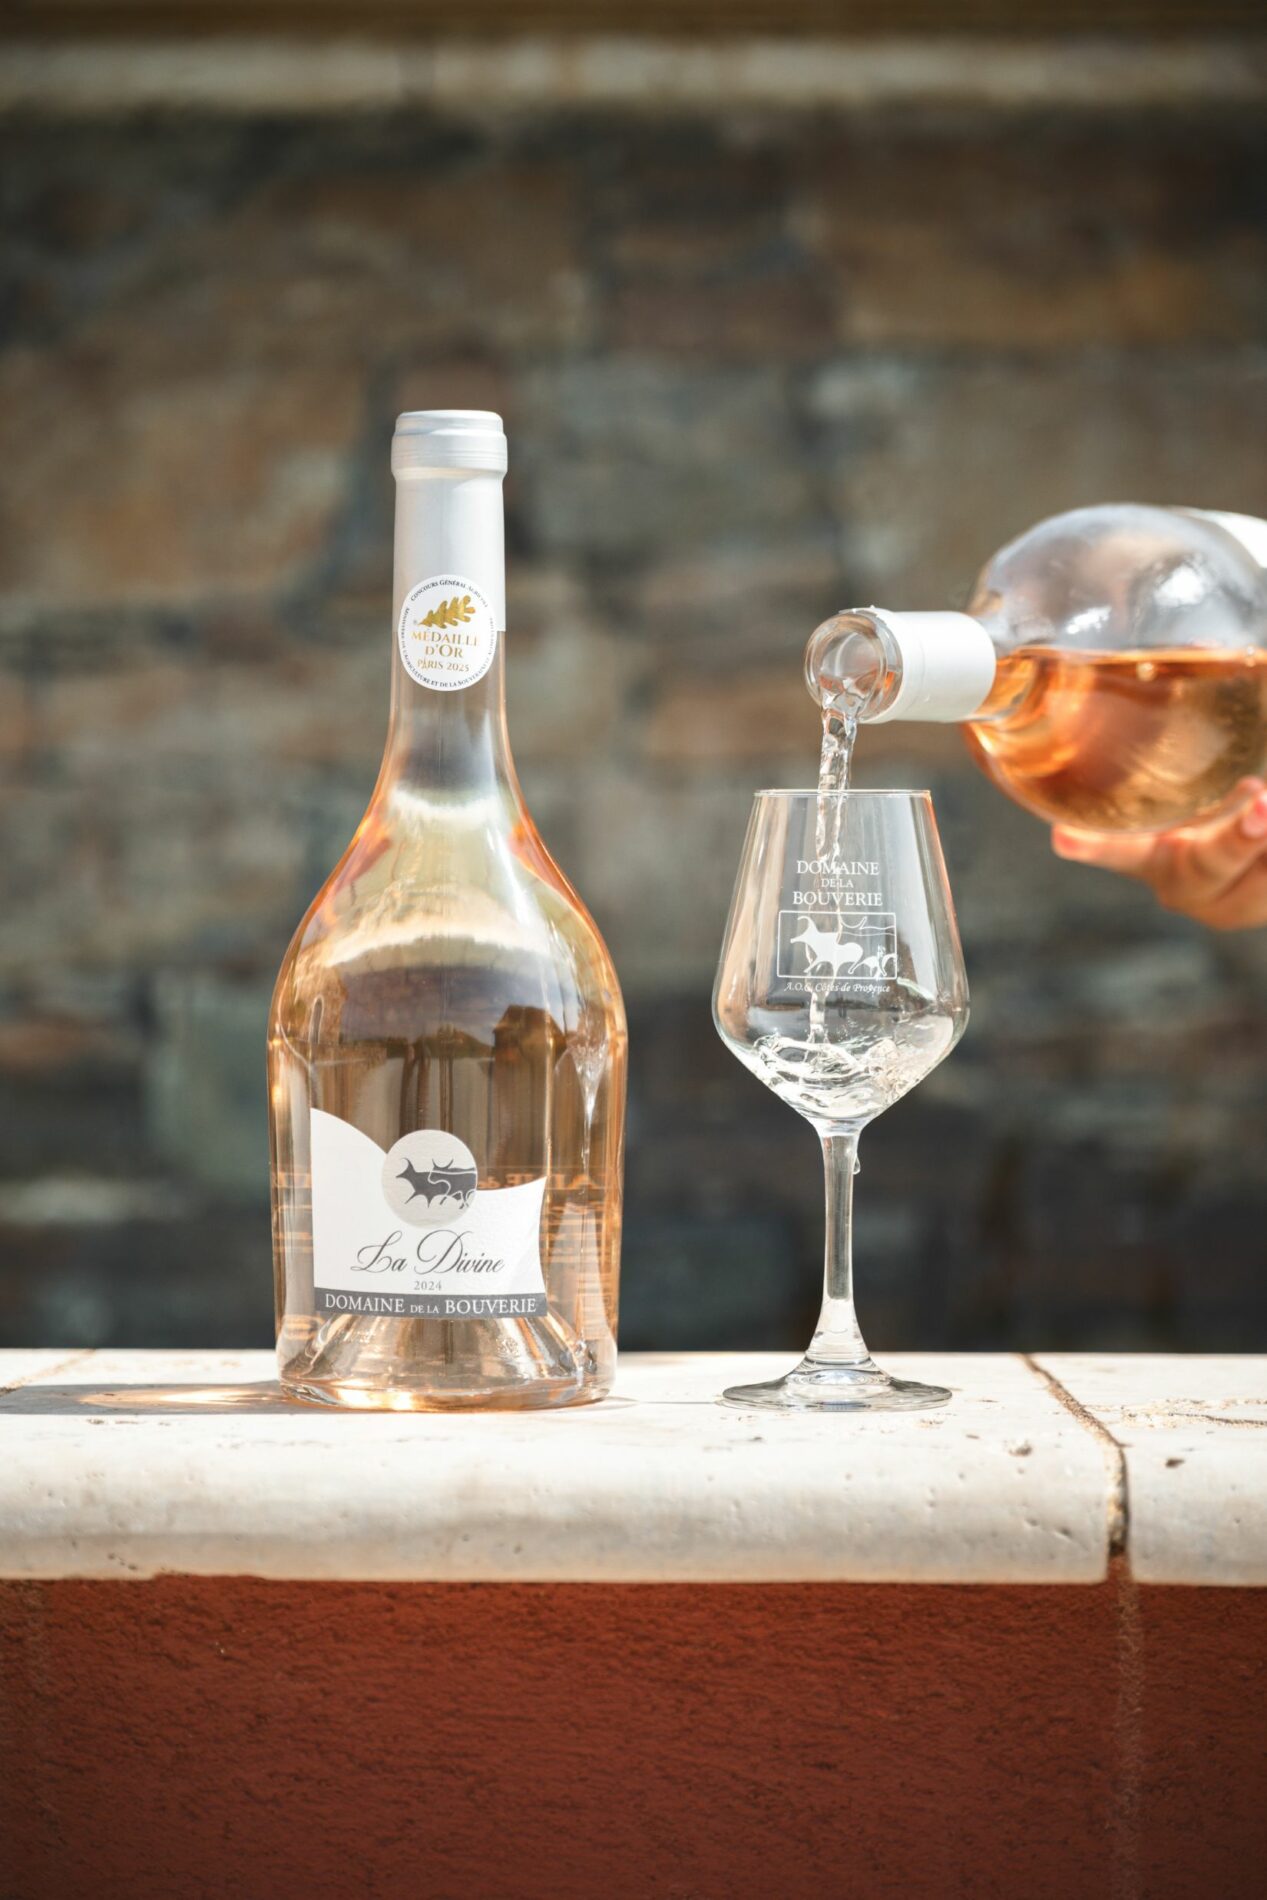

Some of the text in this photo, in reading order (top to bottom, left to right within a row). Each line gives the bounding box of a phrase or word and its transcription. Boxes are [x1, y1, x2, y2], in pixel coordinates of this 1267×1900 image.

[425, 644, 463, 658] D'OR
[417, 657, 470, 673] PARIS 2025
[796, 860, 880, 875] DOMAINE
[821, 879, 854, 888] DE LA
[792, 891, 883, 906] BOUVERIE
[840, 982, 851, 992] de
[350, 1230, 407, 1273] La
[414, 1229, 504, 1275] Divine
[414, 1280, 442, 1291] 2024
[324, 1293, 537, 1315] DOMAINE DE LA BOUVERIE
